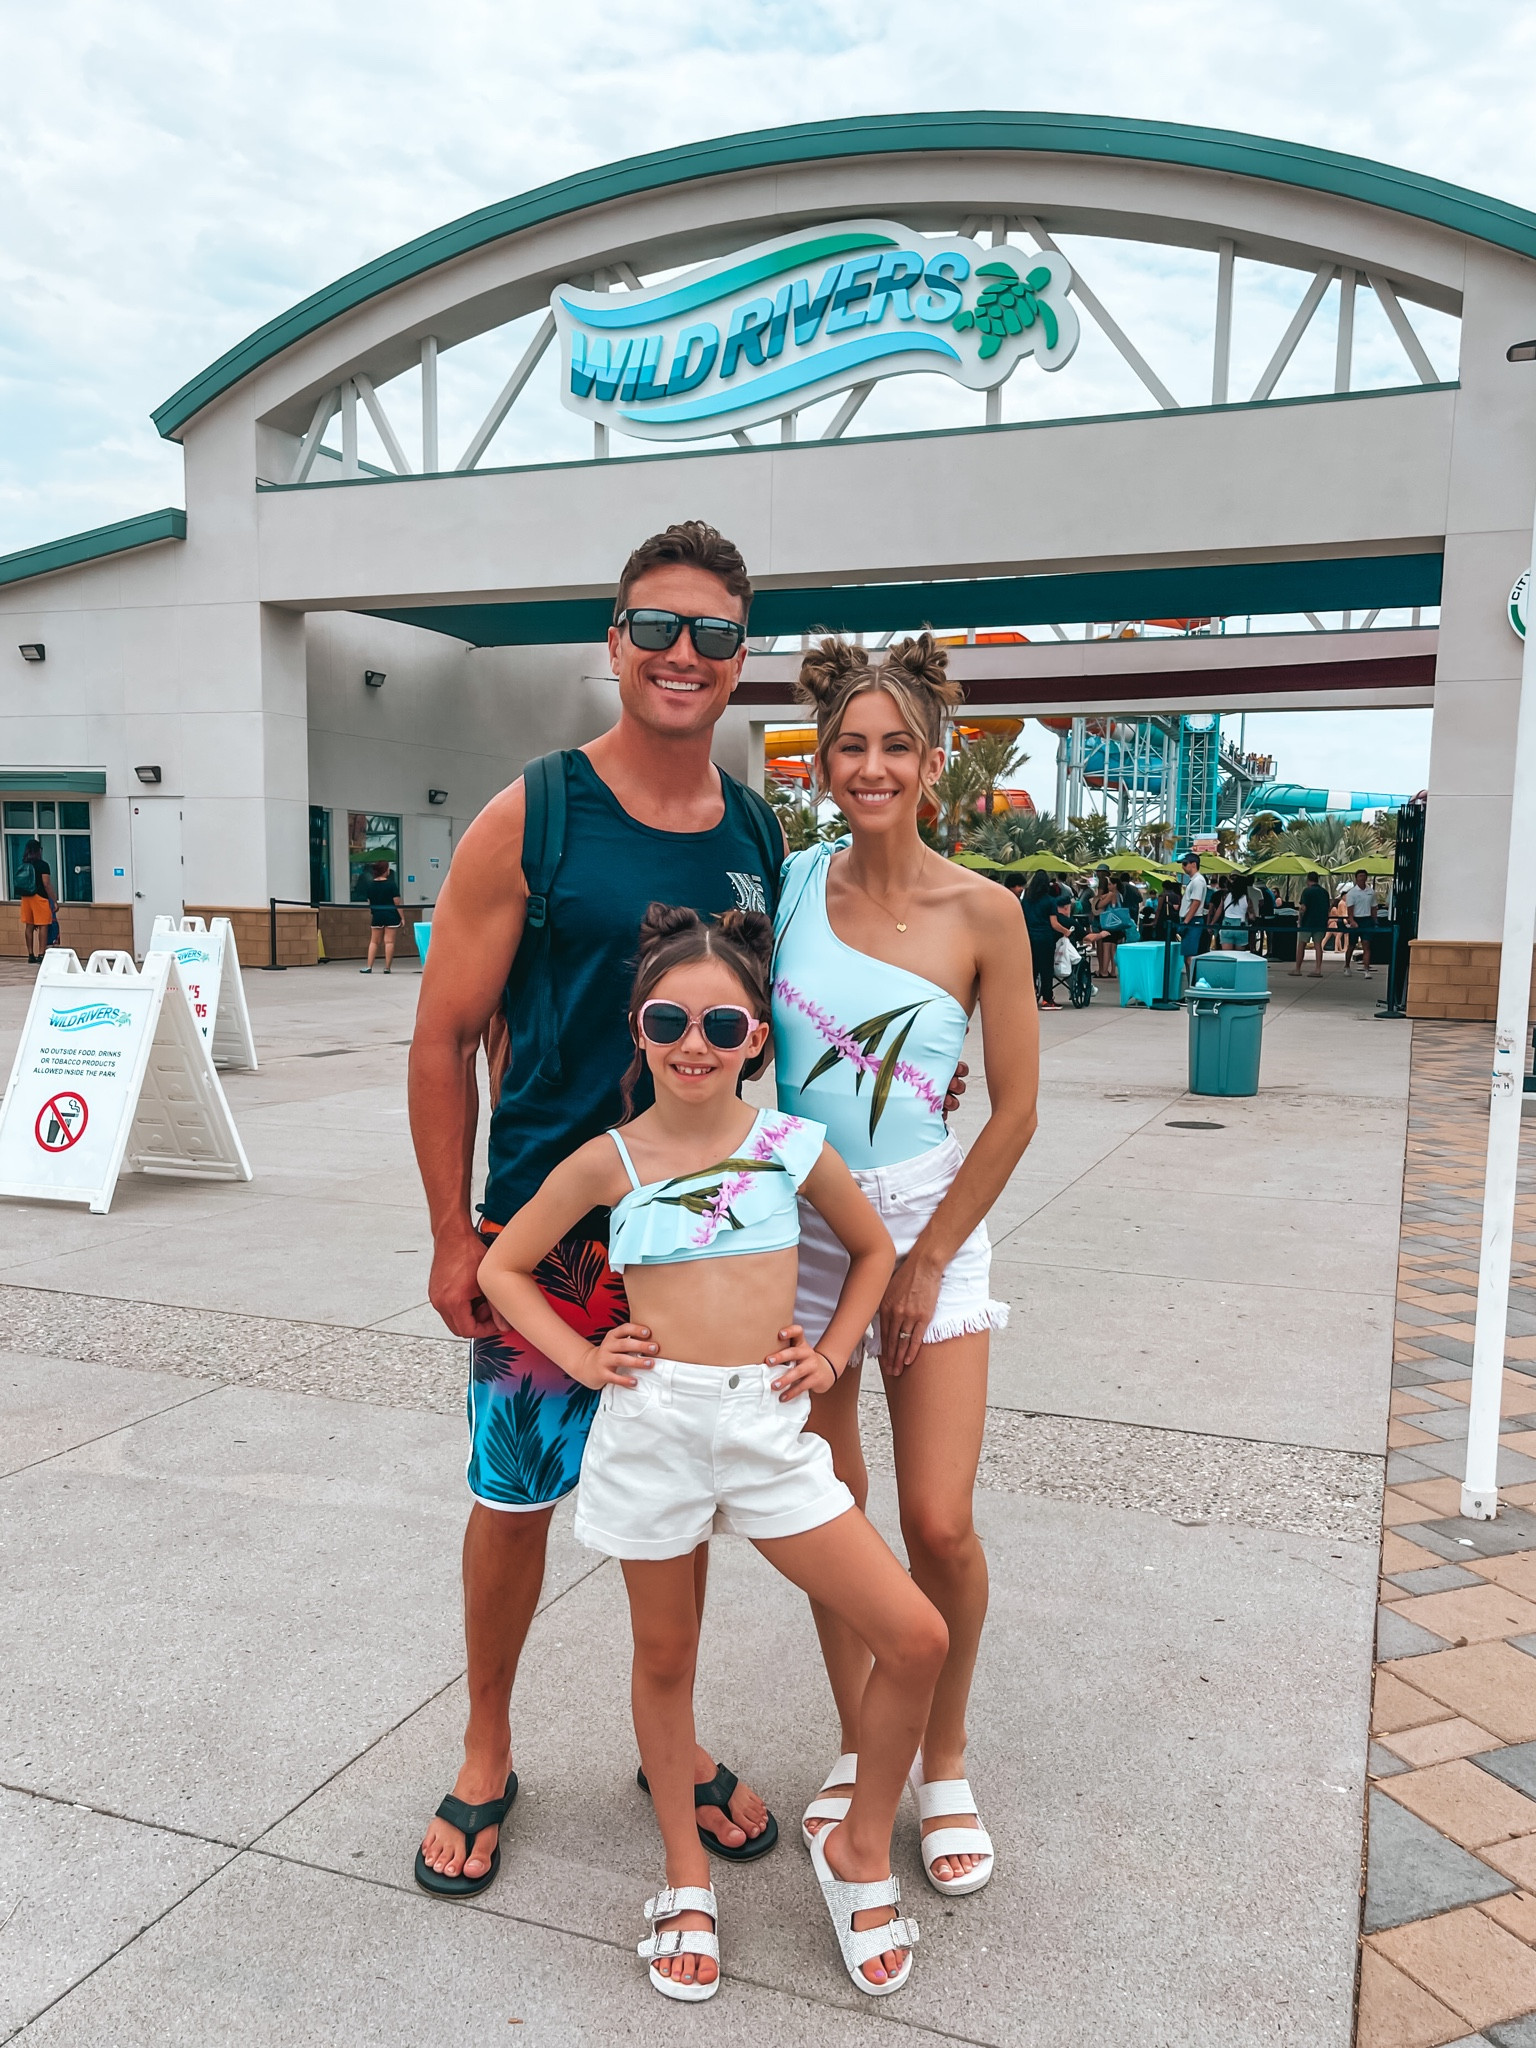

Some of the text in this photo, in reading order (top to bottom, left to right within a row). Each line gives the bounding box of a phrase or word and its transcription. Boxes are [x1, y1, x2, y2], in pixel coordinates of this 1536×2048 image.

[570, 250, 971, 402] WILD RIVERS
[49, 1007, 120, 1027] WILD RIVERS
